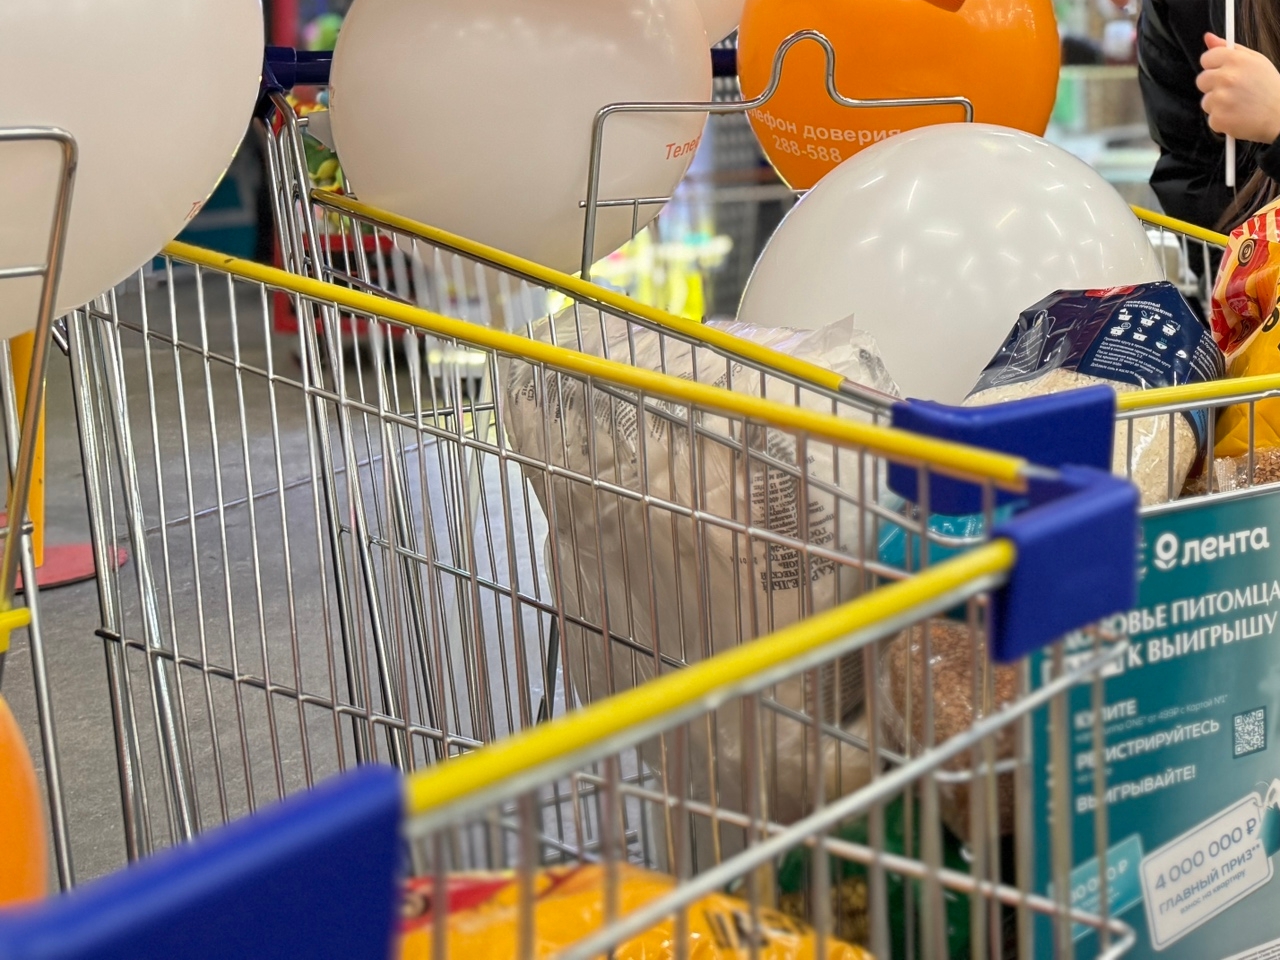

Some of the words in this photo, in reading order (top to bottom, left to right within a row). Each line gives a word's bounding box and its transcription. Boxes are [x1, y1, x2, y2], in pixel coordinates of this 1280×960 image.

[747, 108, 797, 135] лефон
[772, 134, 842, 163] 288-588
[1182, 527, 1270, 565] лента
[1147, 611, 1278, 663] ВЫИГРЫШУ
[1076, 718, 1220, 771] РЕИСТРИРУЙТЕСЬ
[1155, 873, 1167, 890] 4
[1168, 850, 1205, 884] 000
[1208, 826, 1243, 858] 000
[1158, 867, 1219, 915] ГЛАВНЫЙ
[1202, 890, 1213, 901] на
[1213, 868, 1247, 894] квартиру
